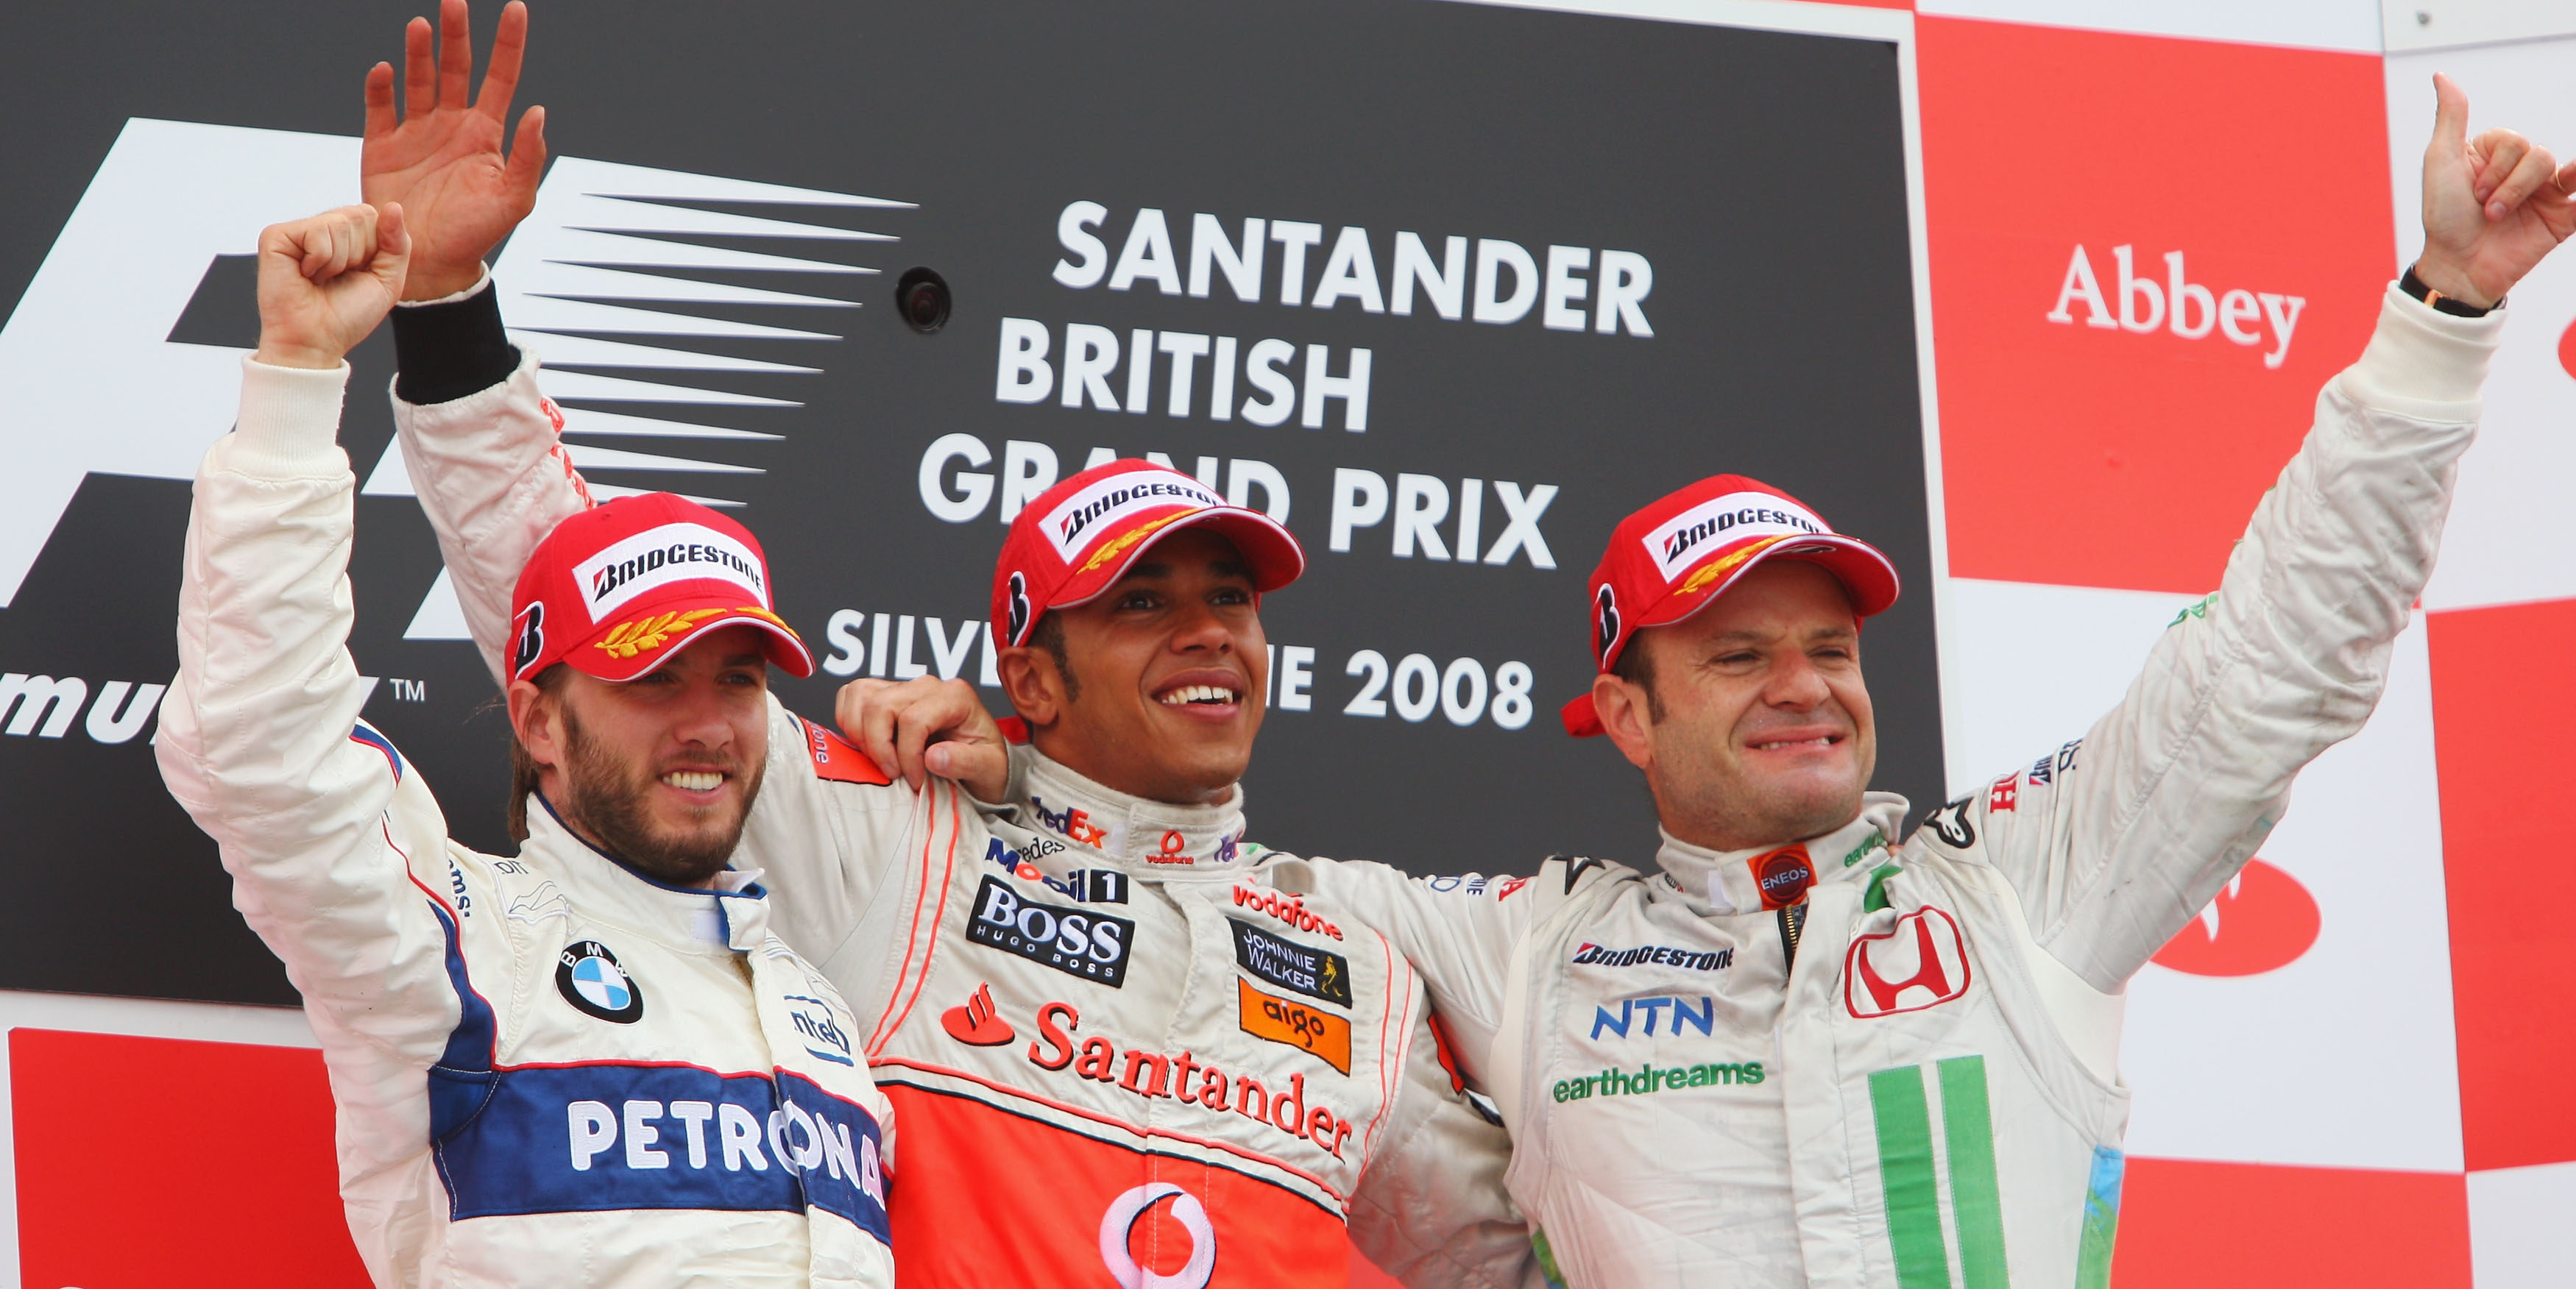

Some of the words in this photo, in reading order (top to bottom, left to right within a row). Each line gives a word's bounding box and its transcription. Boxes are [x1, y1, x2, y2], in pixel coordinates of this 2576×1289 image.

[1052, 200, 1655, 338] SANTANDER
[2046, 244, 2307, 368] Abbey
[995, 317, 1373, 432] BRITISH
[1061, 483, 1217, 545] BRIDGESTO
[1329, 467, 1559, 569] PRIX
[1664, 508, 1819, 564] BRIDGESTO
[593, 544, 762, 603] BRIDGESTONE
[390, 678, 425, 702] TM
[1342, 649, 1534, 730] 2008
[1145, 854, 1195, 865] vodafone
[1761, 866, 1809, 891] ENEOS
[978, 884, 1121, 963] BOSS
[1234, 884, 1344, 941] vodafone
[561, 941, 629, 978] BMW
[977, 925, 1036, 952] HUGO
[1052, 954, 1113, 977] BOSS
[1244, 928, 1317, 971] JOHNNIE
[1248, 945, 1317, 990] WALKER
[1573, 942, 1734, 970] BRIDGESTONE
[1264, 1000, 1325, 1048] aigo
[1590, 996, 1713, 1040] NTN
[1027, 1001, 1353, 1165] Santander
[1553, 1062, 1765, 1103] earthdreams
[567, 1099, 885, 1212] PETRONA
